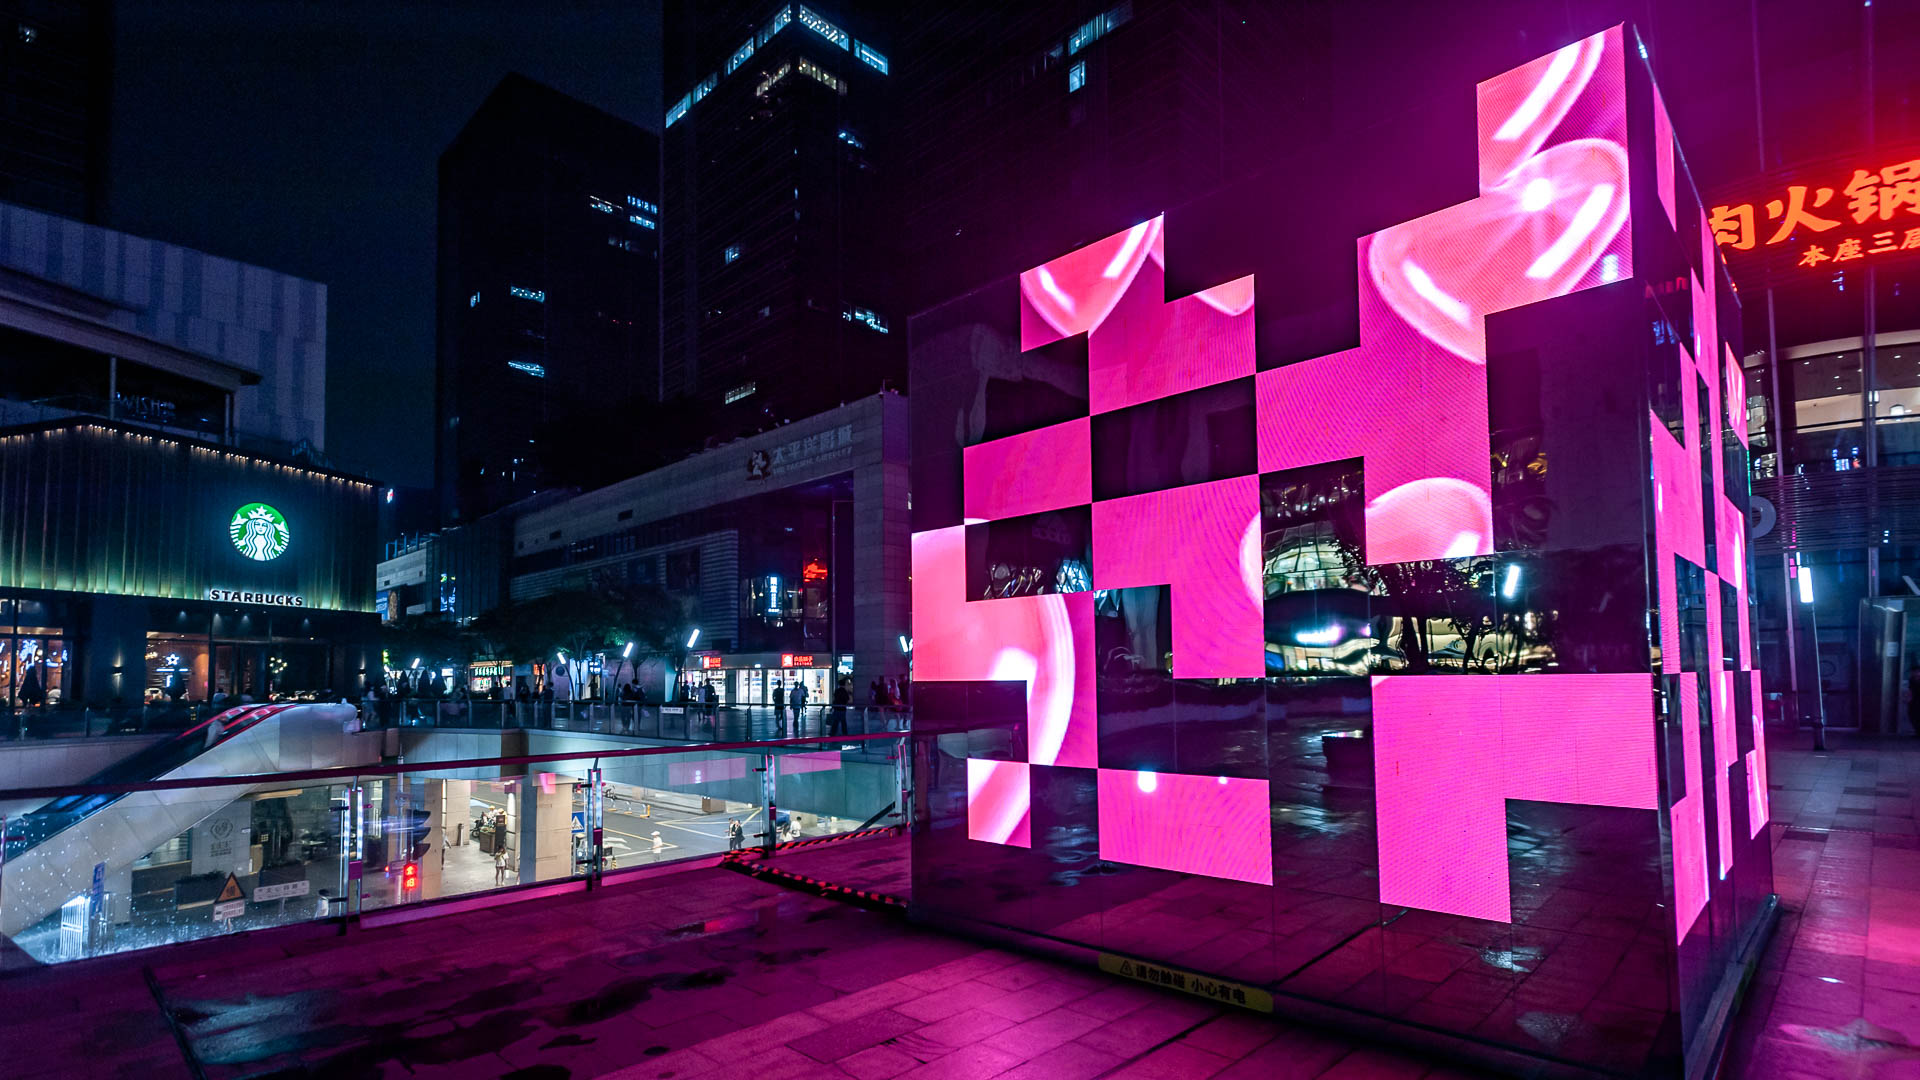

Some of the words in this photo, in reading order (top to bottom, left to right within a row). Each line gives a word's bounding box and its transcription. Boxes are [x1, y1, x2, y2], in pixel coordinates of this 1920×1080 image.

[209, 588, 303, 607] STARBUCKS
[1136, 964, 1185, 989] 请勿触碰
[1191, 978, 1246, 1004] 小心有电
